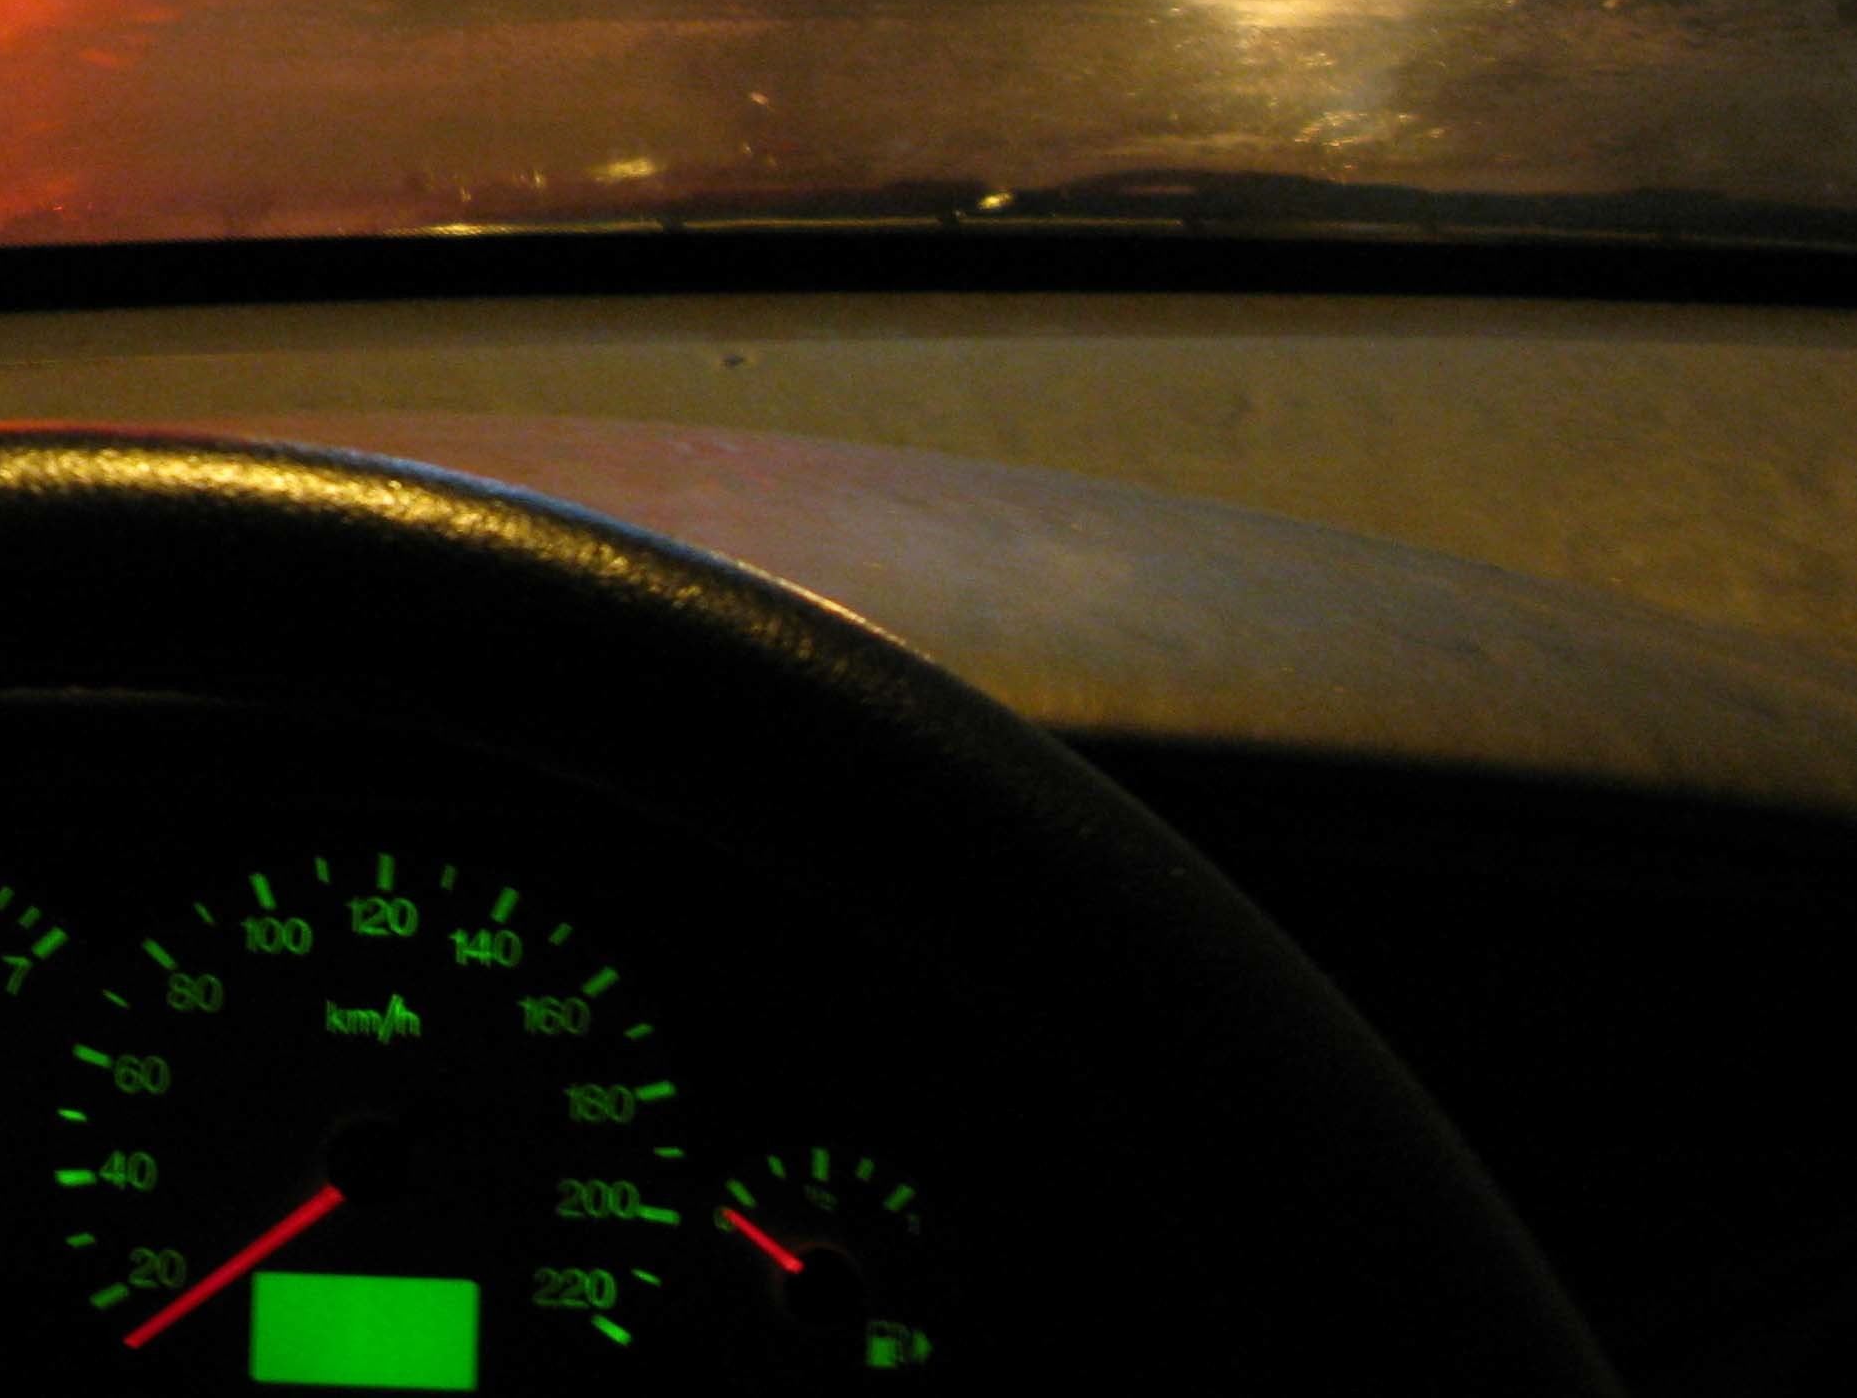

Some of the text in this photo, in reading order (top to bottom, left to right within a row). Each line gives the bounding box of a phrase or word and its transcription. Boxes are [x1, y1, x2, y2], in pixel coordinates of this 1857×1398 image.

[242, 917, 313, 955] 100
[347, 896, 419, 937] 120
[449, 928, 522, 967] 140
[1, 954, 34, 996] 7
[166, 973, 224, 1013] 80
[326, 994, 422, 1044] km/h
[518, 996, 590, 1035] 160
[113, 1055, 170, 1095] 60
[565, 1084, 635, 1123] 180
[99, 1151, 157, 1190] 40
[557, 1179, 640, 1219] 200
[129, 1247, 187, 1288] 20
[534, 1268, 618, 1309] 220
